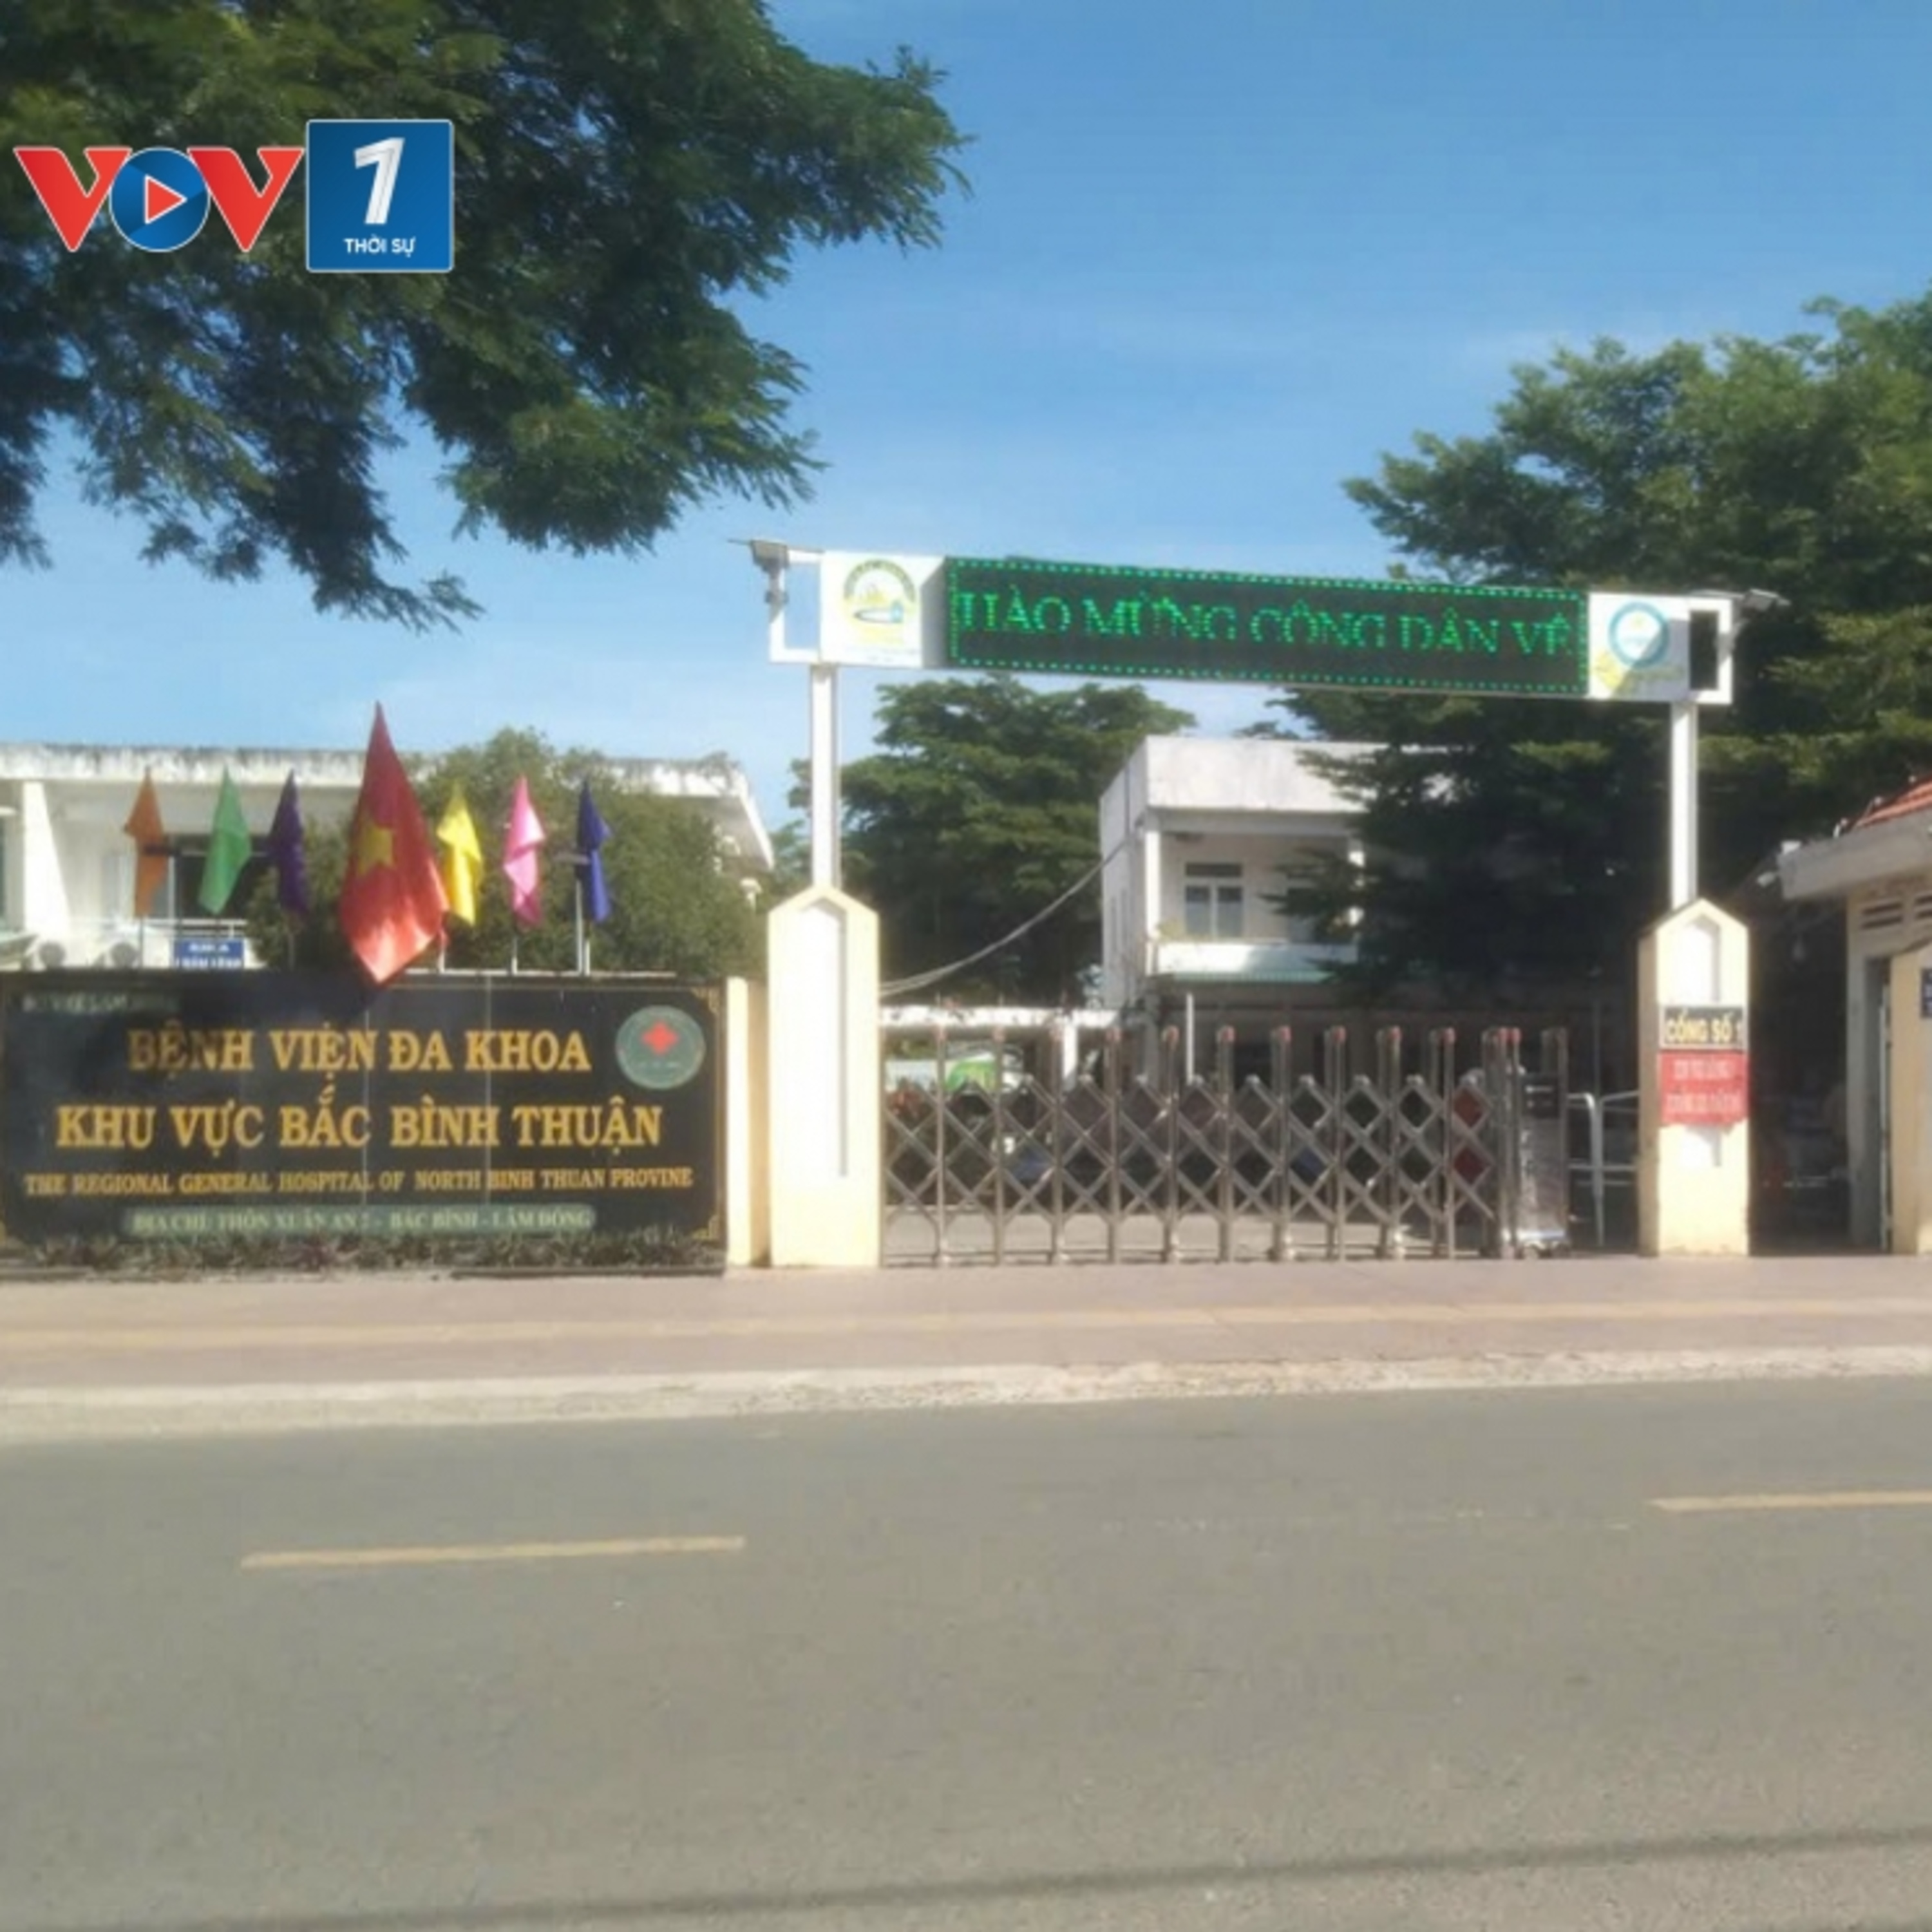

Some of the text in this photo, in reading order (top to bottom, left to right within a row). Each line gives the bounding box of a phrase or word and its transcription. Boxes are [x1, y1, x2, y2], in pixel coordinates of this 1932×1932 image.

[1250, 598, 1385, 648] CÔNG
[1397, 607, 1500, 652] DÂN
[129, 1019, 592, 1080] BỆNH VIỆN ĐA KHOA
[57, 1084, 663, 1158] KHU VỰC BẮC BÌNH THUẬN
[24, 1166, 694, 1195] THE REGIONAL GENERAL HOSPITAL OF NORTH BINH THUAN PROVINE
